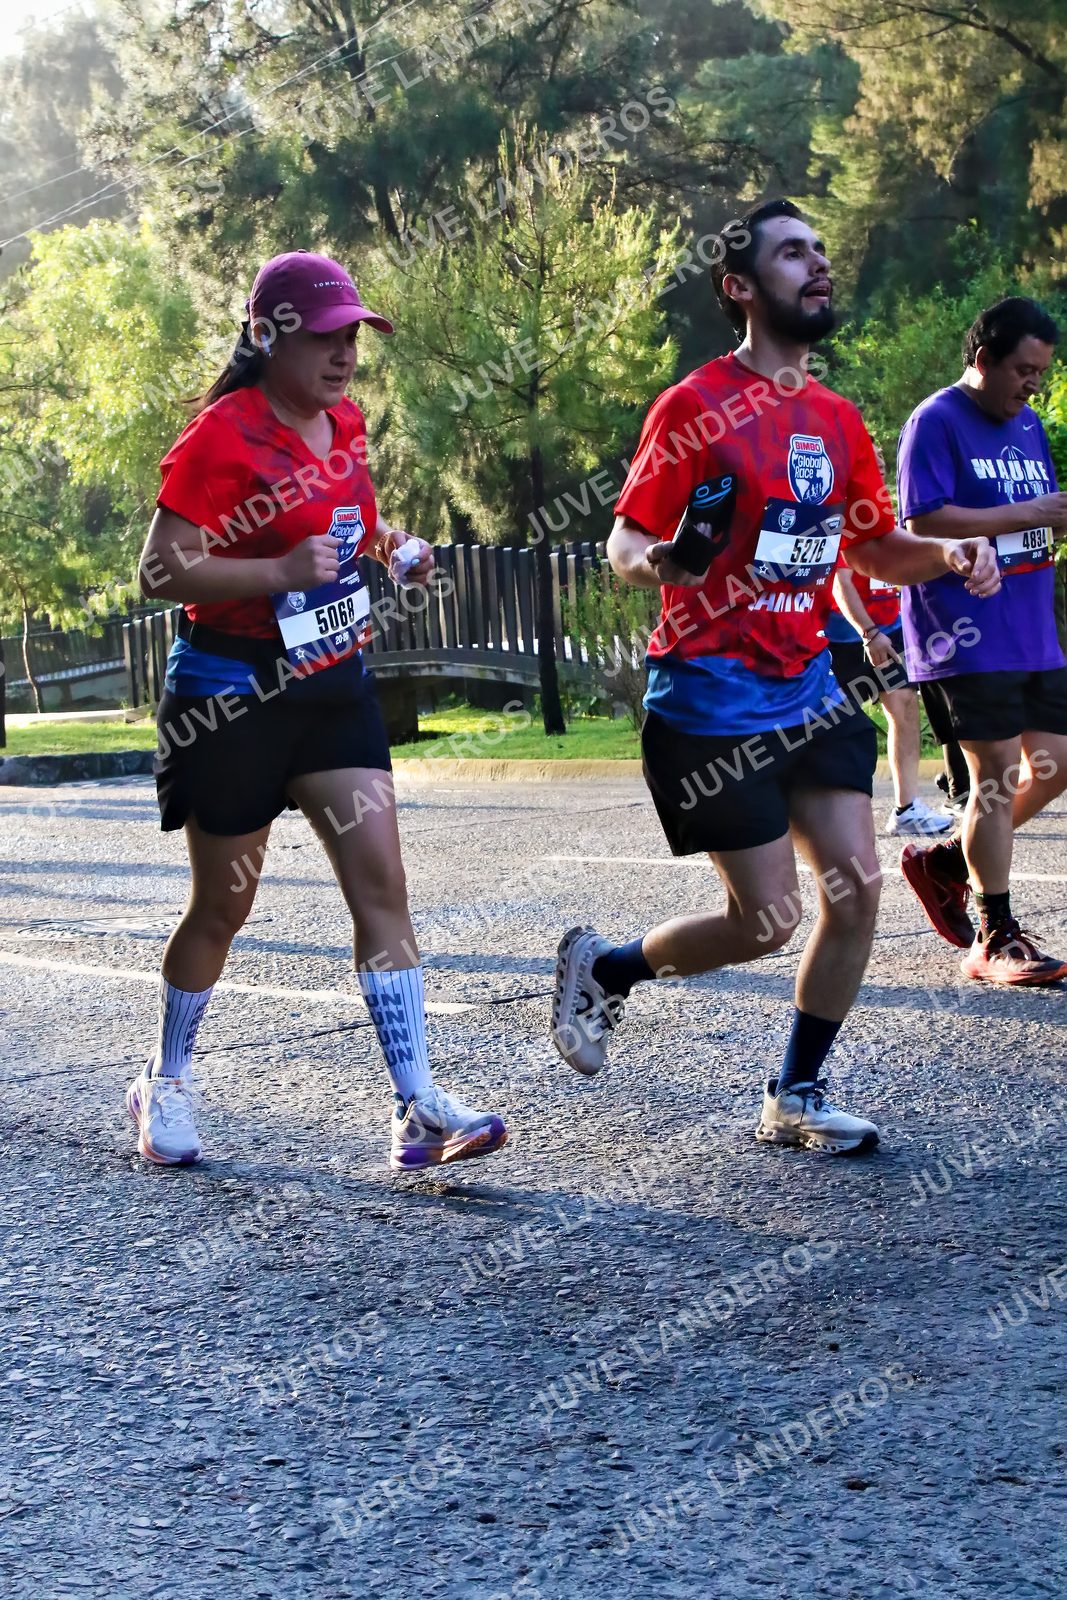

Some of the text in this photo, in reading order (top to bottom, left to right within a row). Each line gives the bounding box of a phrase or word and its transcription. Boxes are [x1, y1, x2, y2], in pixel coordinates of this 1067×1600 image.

[795, 441, 821, 451] BIMBO
[797, 455, 822, 468] Global
[794, 465, 814, 479] Race
[1022, 529, 1047, 550] 4834
[790, 537, 827, 563] 5276
[314, 596, 355, 636] 5068
